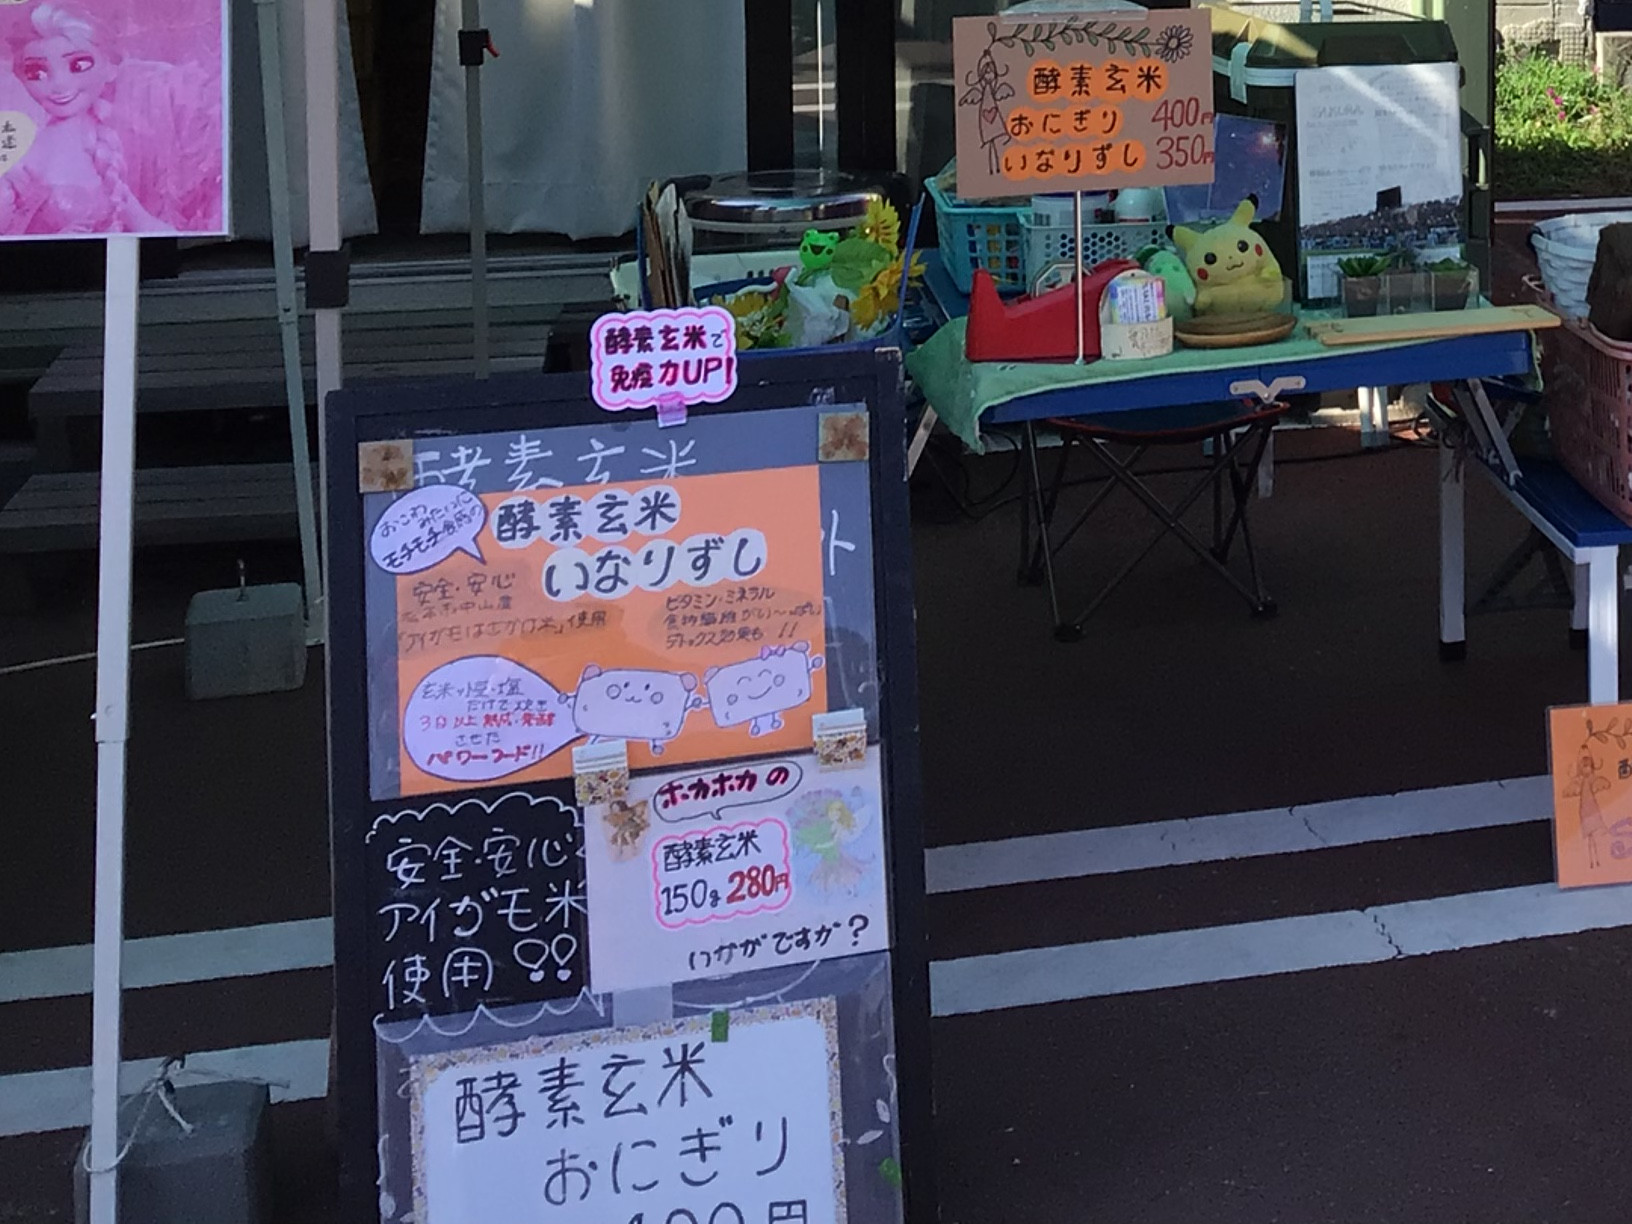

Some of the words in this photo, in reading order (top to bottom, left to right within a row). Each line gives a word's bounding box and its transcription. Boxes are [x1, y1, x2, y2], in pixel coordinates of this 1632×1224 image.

[1033, 64, 1162, 97] 酵素玄米
[1010, 108, 1117, 138] おにぎり
[1151, 97, 1214, 132] 400円
[1004, 142, 1139, 174] いなりずし
[1156, 134, 1216, 171] 350円
[498, 492, 678, 542] 酵素玄米
[546, 535, 764, 597] いなりずし
[663, 829, 762, 873] 酵素玄米
[661, 879, 722, 916] 150g
[726, 864, 790, 905] 280円
[455, 1041, 713, 1144] 酵素玄米
[545, 1115, 789, 1207] おにぎり
